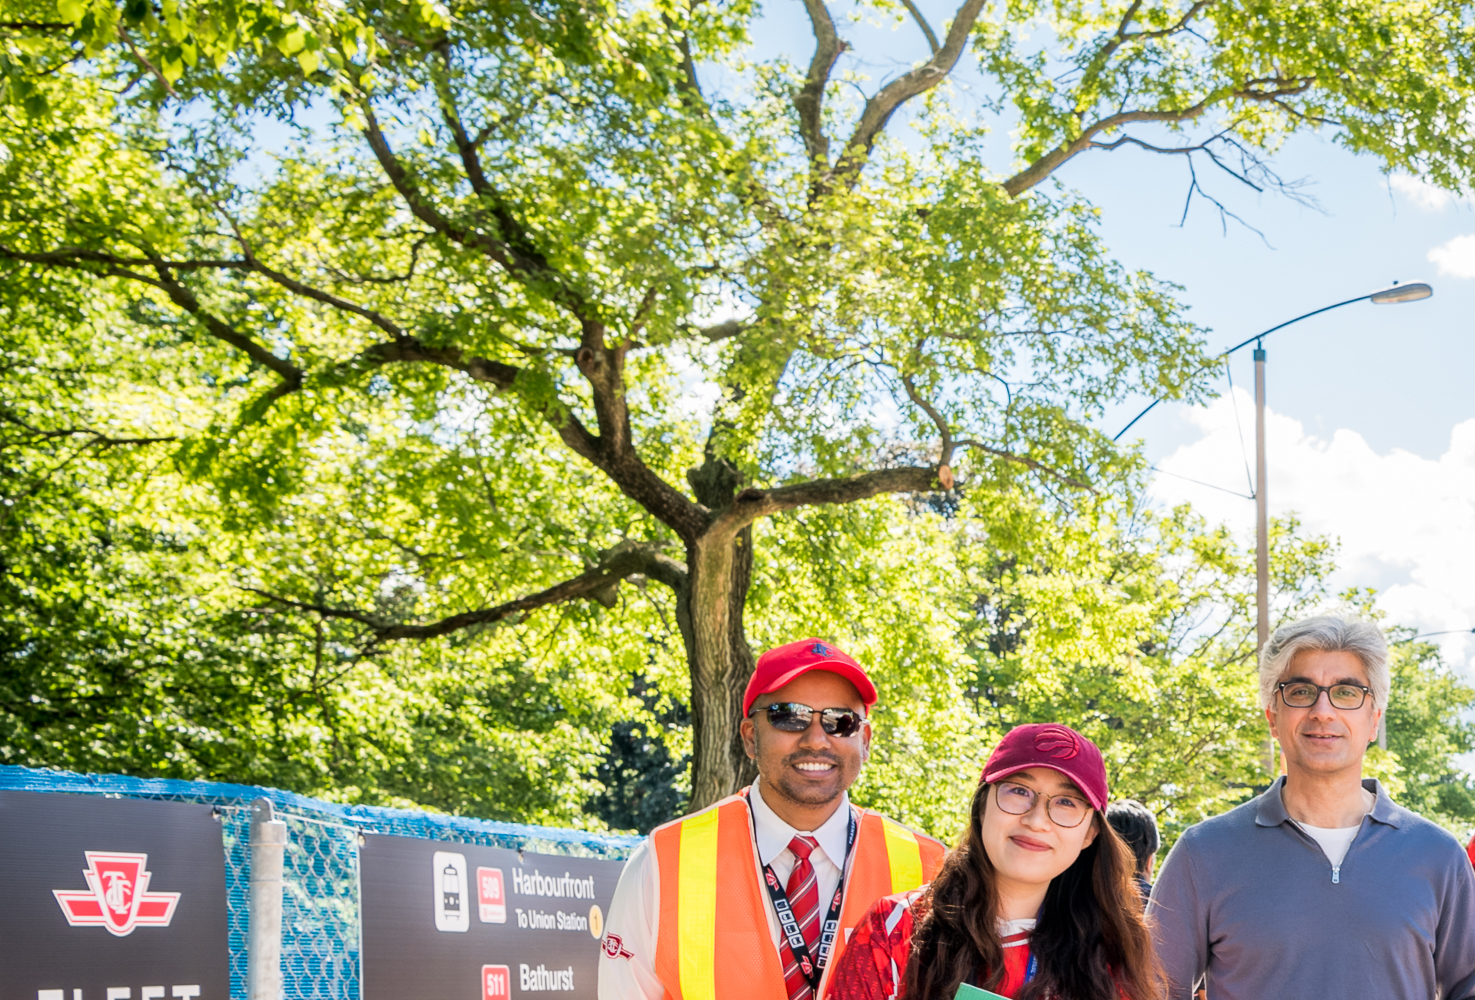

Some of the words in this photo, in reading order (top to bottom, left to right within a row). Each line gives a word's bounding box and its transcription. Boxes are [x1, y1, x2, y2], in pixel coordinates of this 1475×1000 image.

[482, 876, 500, 899] 509
[512, 867, 595, 899] Harbourfront
[515, 908, 528, 928] To
[529, 910, 555, 929] Union
[557, 912, 587, 931] Station
[487, 973, 505, 996] 511
[519, 963, 574, 992] Bathurst
